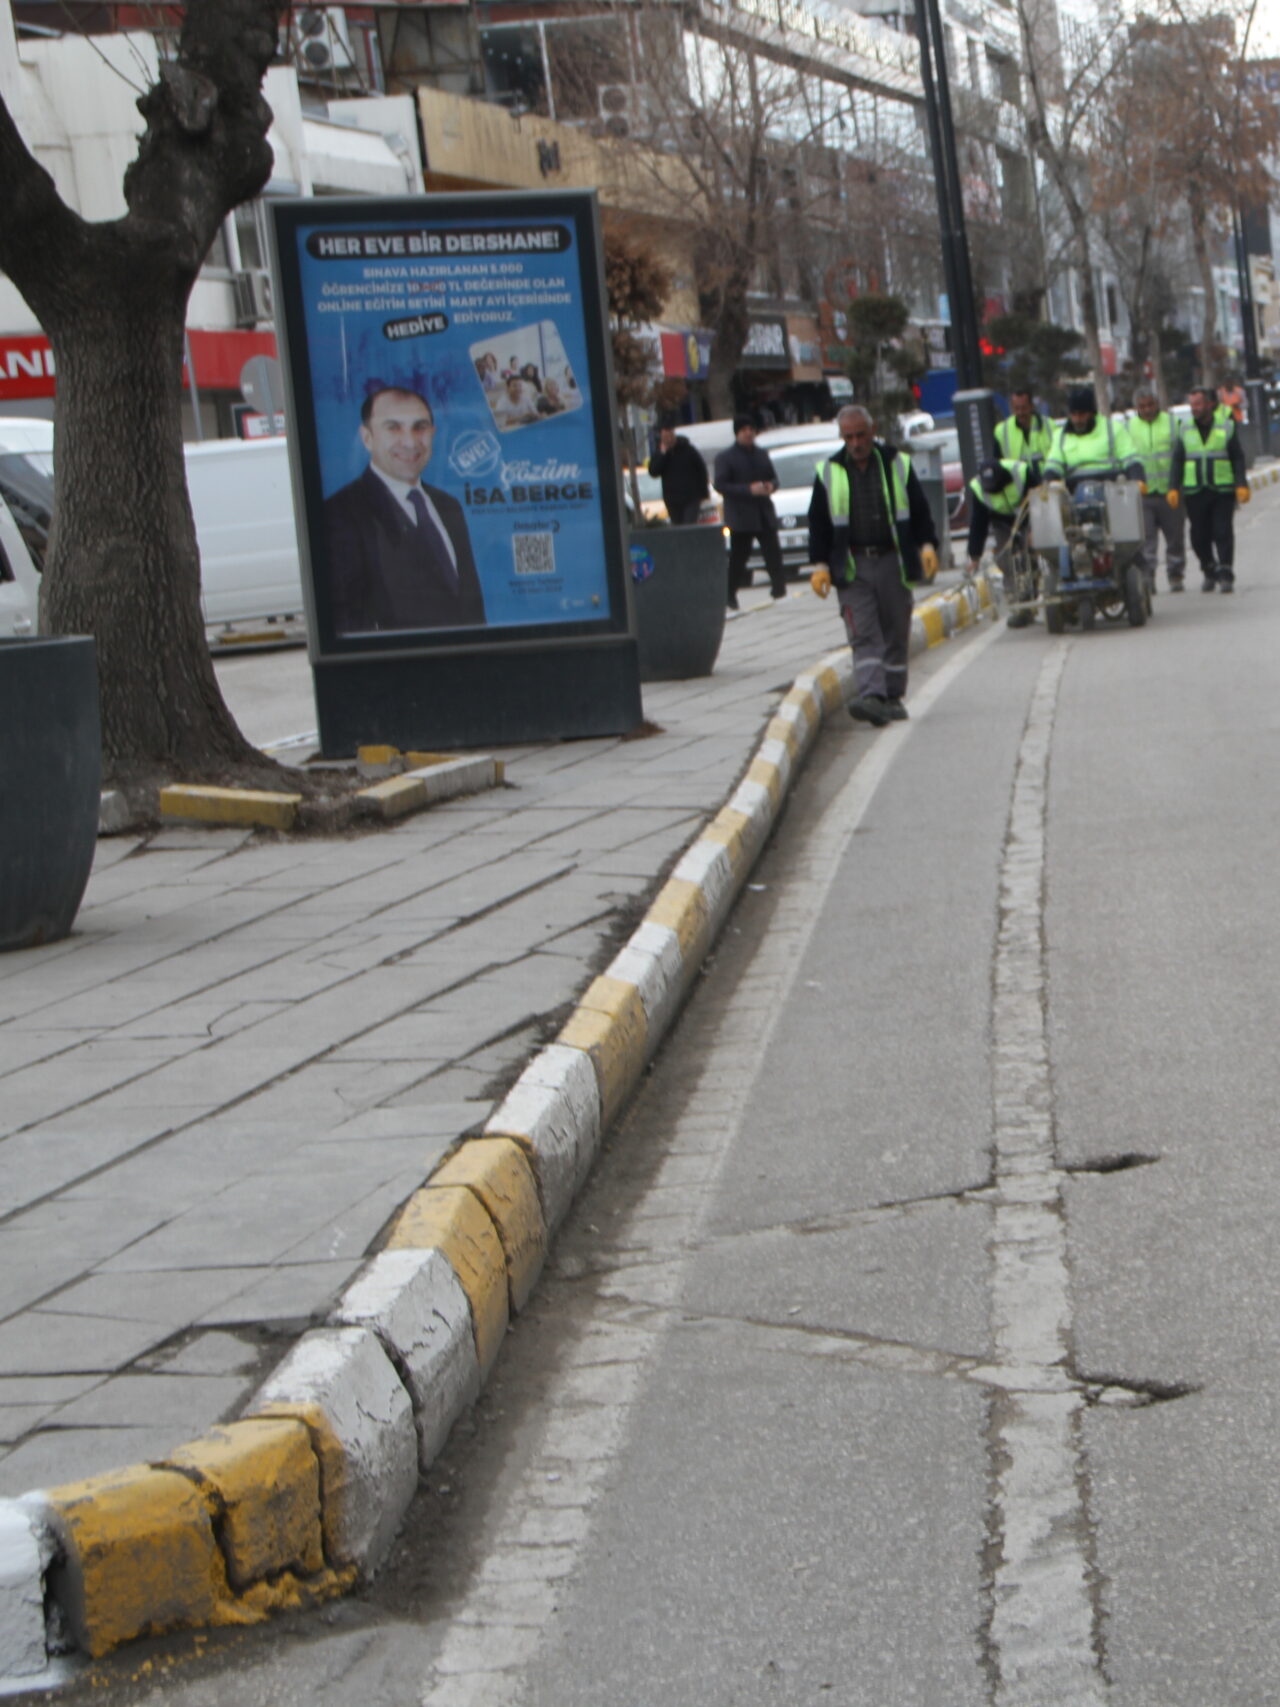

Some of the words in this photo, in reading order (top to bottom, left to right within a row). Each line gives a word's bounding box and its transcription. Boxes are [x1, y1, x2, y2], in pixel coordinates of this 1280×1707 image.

[318, 236, 361, 256] HER
[364, 234, 405, 254] EVE
[413, 230, 442, 253] BİR
[446, 231, 560, 251] DERSHANE!
[363, 266, 408, 279] SINAVA
[410, 264, 488, 277] HAZIRLANAN
[449, 281, 462, 292] TL
[533, 277, 565, 290] OLAN
[450, 295, 483, 308] MART
[386, 314, 445, 339] HEDİYE
[500, 458, 581, 489] Çözüm
[464, 481, 507, 506] İSA
[511, 481, 594, 503] BERGE
